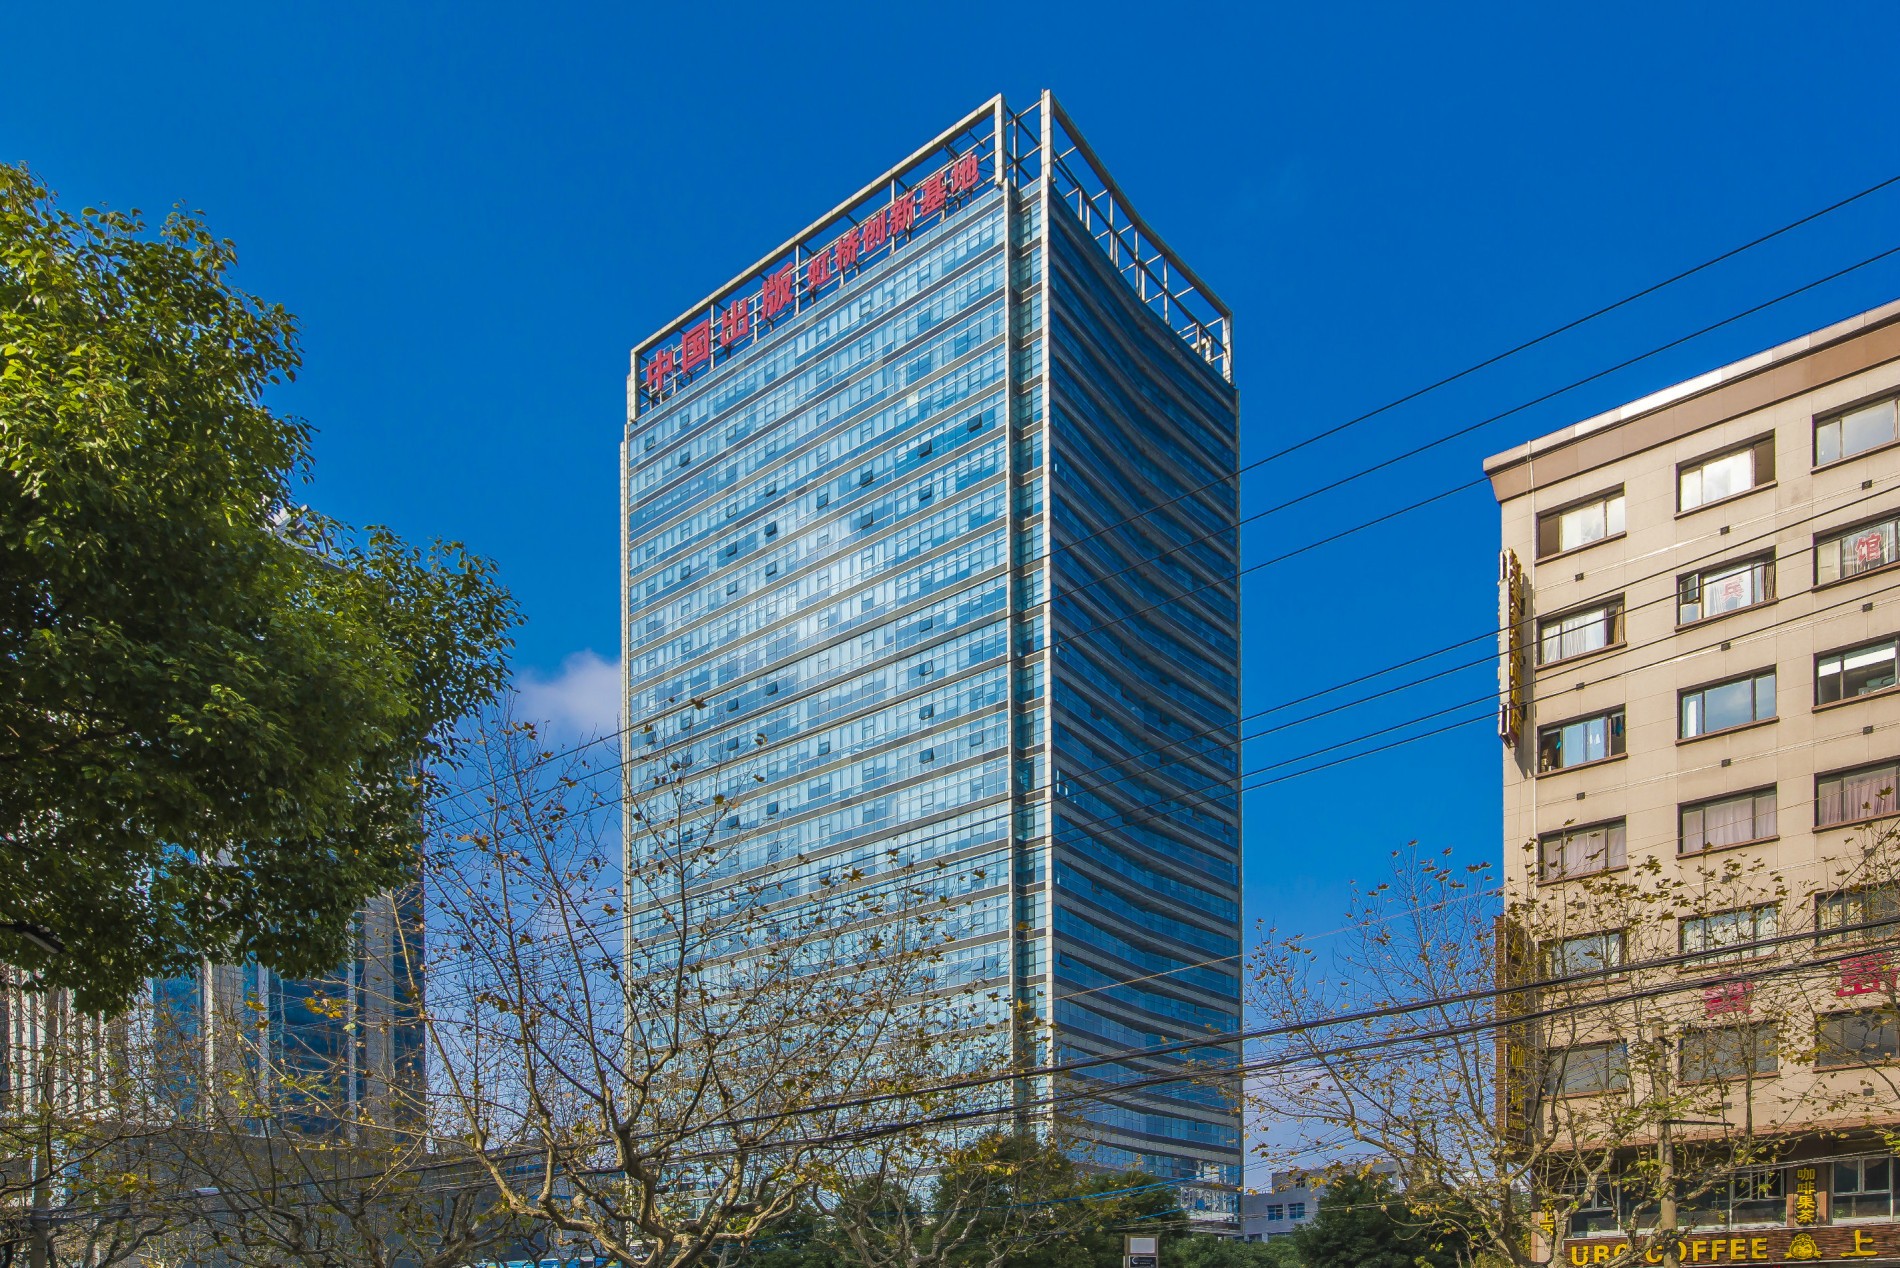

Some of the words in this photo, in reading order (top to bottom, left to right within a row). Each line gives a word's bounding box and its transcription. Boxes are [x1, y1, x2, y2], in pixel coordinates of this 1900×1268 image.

[1855, 533, 1882, 562] 馆
[1796, 1167, 1817, 1224] 咖啡果茶
[1840, 1229, 1879, 1257] 上
